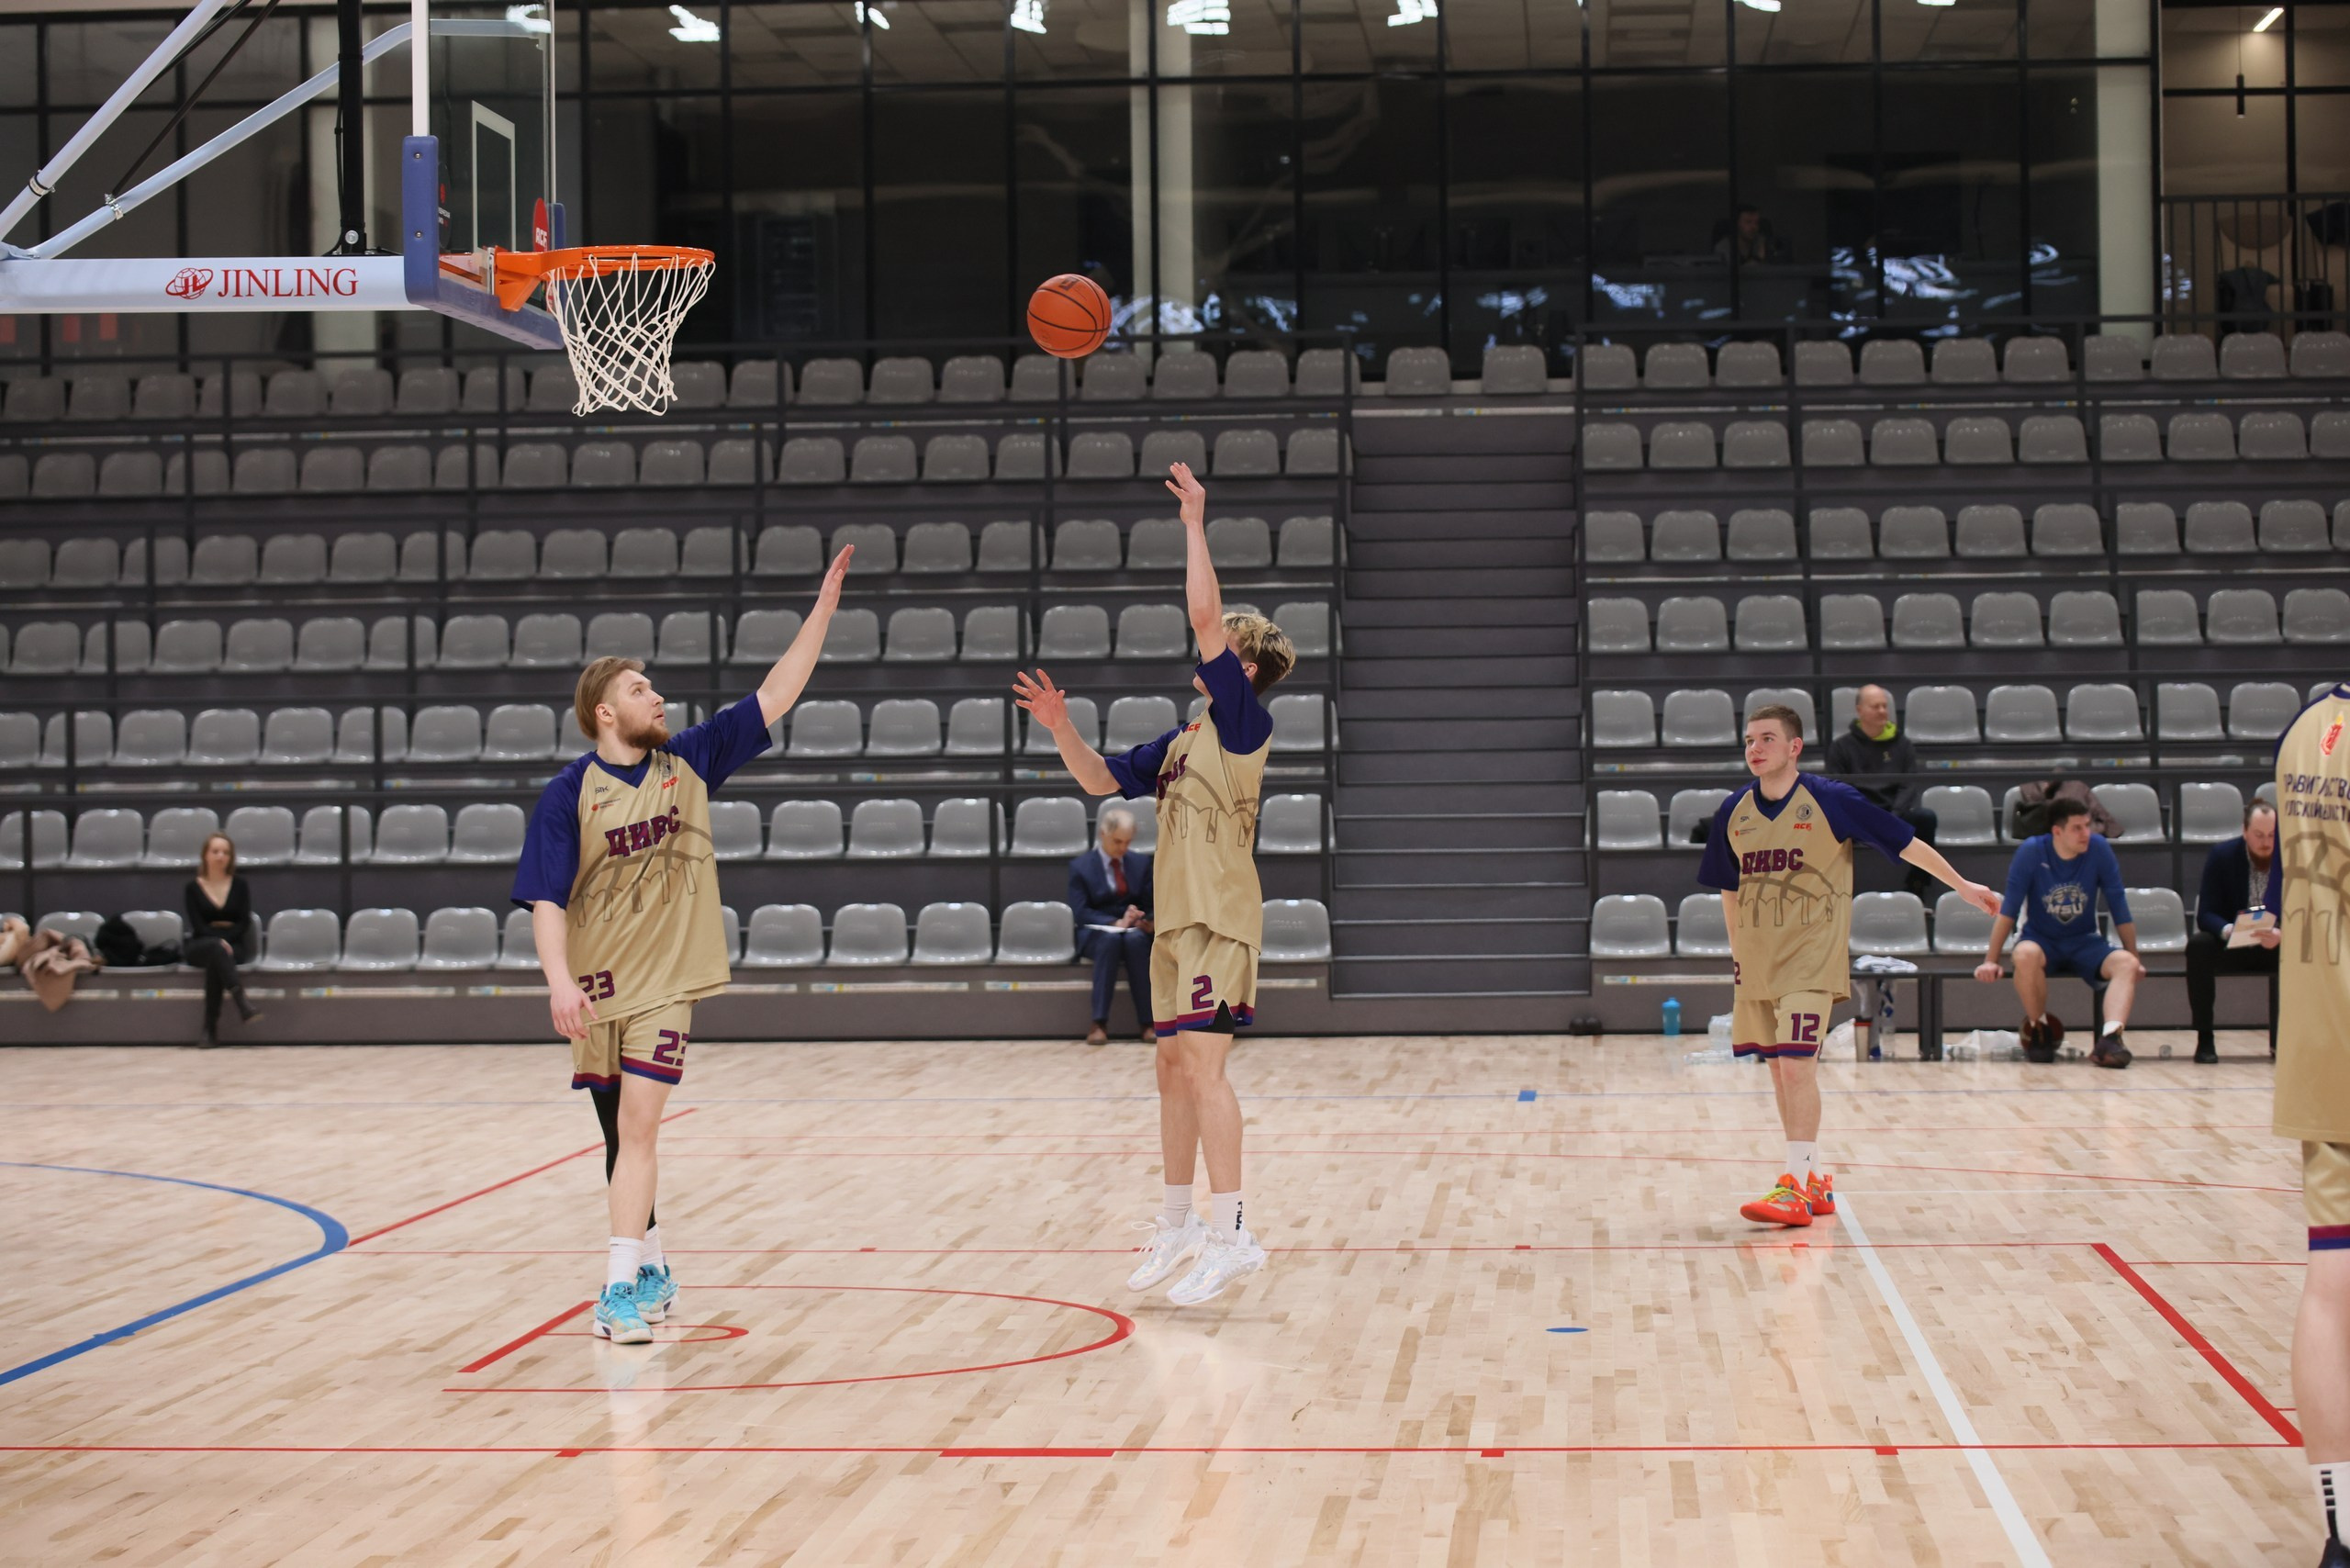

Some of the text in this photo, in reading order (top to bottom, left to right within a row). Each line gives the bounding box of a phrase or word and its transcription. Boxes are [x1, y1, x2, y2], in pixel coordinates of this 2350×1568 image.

[218, 268, 359, 297] JINLING
[1741, 848, 1804, 875] ЦИВС
[1192, 975, 1214, 1010] 2
[1791, 1013, 1821, 1042] 12
